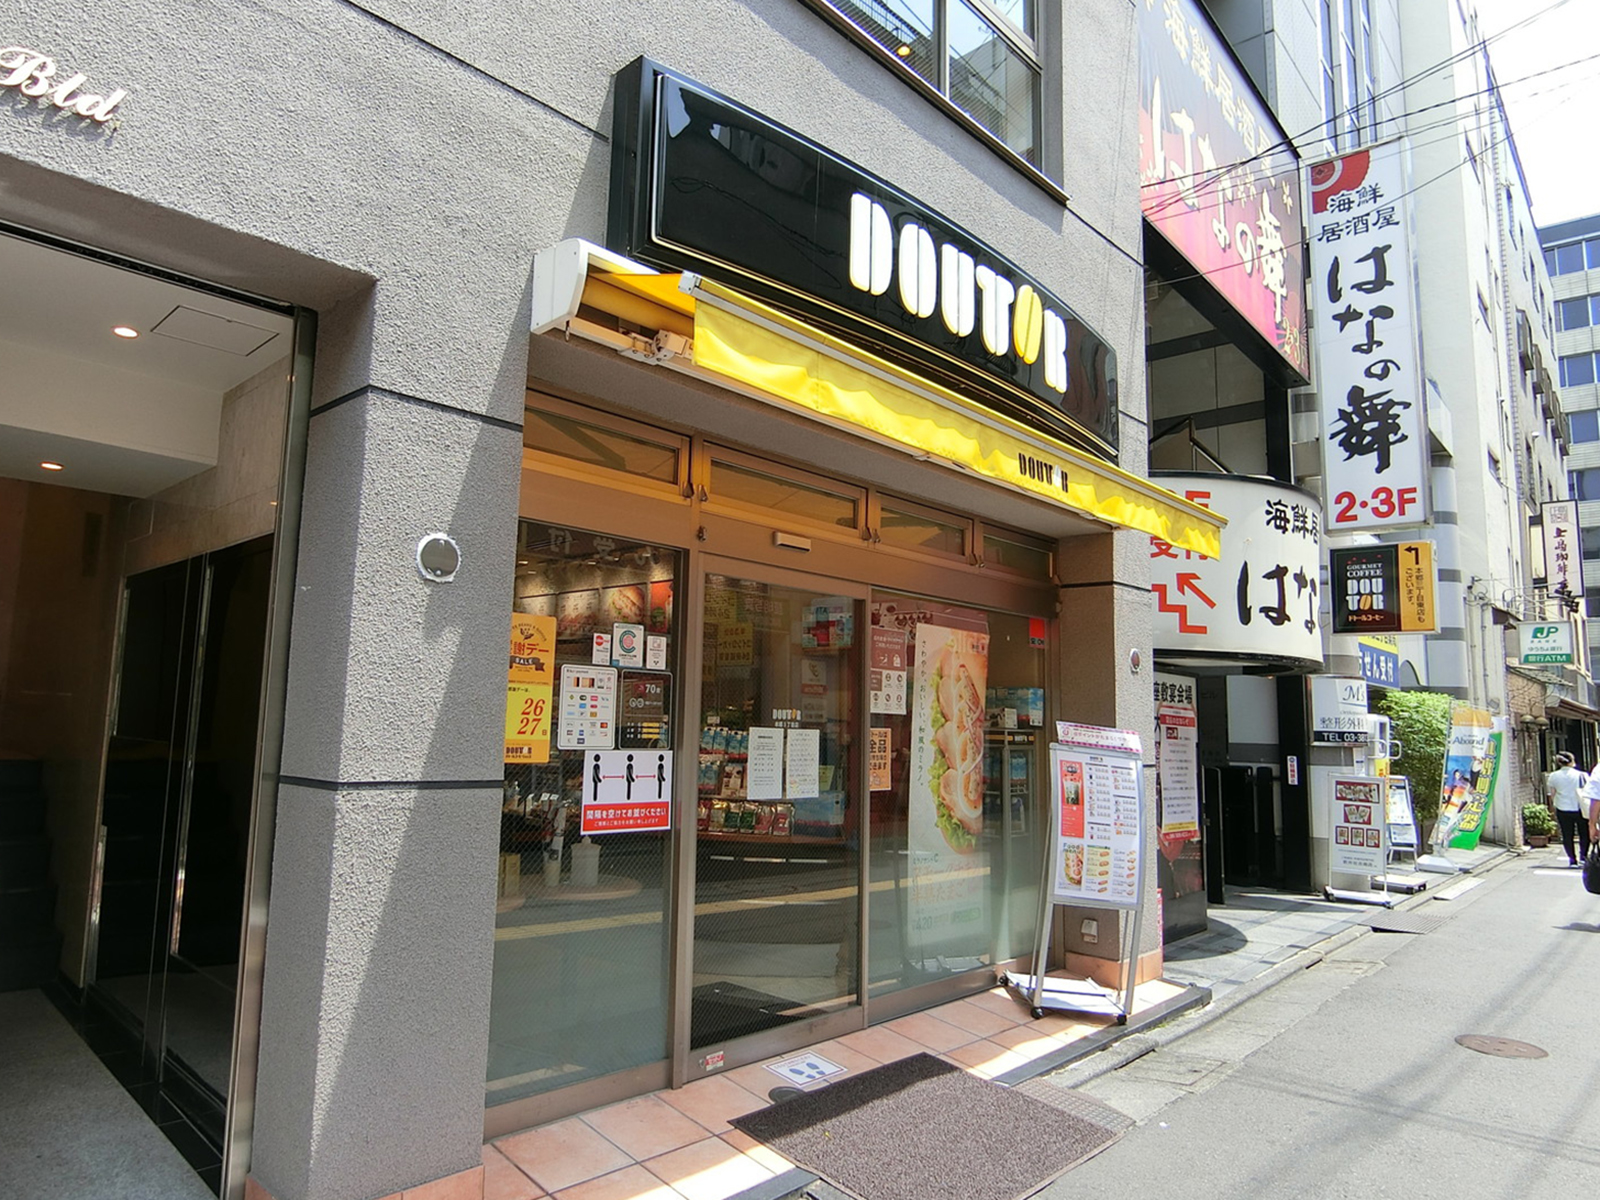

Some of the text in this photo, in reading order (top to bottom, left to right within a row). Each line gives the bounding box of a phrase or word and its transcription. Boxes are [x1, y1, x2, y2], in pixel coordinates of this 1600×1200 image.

[1328, 183, 1385, 214] 海鮮
[1317, 206, 1401, 243] 居酒屋
[849, 192, 1068, 394] DOUTOR
[1327, 244, 1412, 474] はなの舞
[1346, 569, 1383, 578] COFFEE
[1237, 560, 1318, 635] はな
[1348, 613, 1385, 622] ドトールコーヒー
[510, 641, 549, 656] 謝デー
[521, 697, 546, 717] 26
[517, 717, 542, 736] 27
[1322, 732, 1342, 742] TEL
